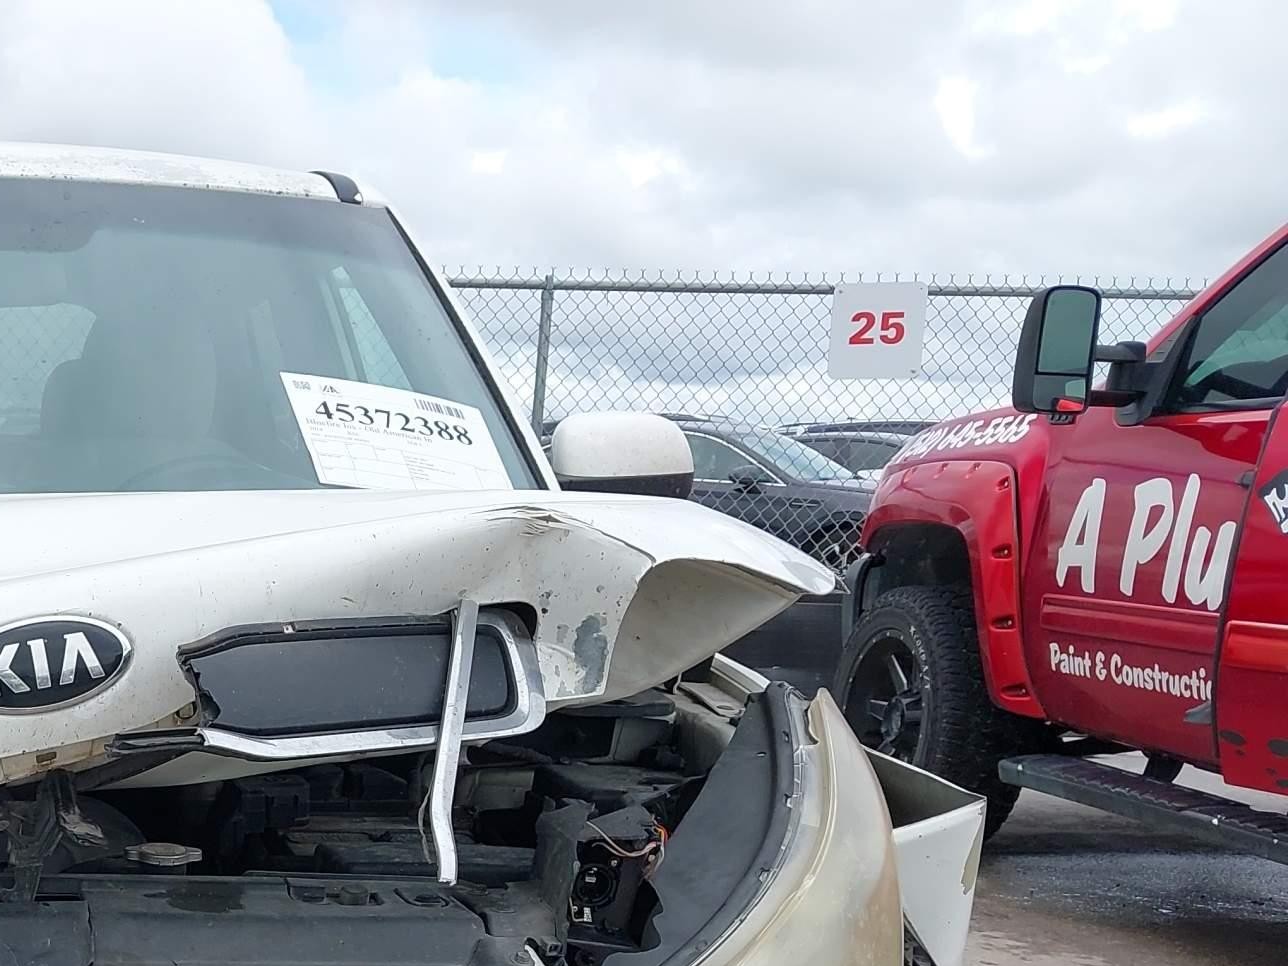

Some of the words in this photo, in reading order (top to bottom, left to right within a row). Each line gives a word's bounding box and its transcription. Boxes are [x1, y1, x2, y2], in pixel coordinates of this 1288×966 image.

[848, 311, 905, 345] 25
[315, 401, 473, 445] 45372388
[1055, 477, 1107, 594] A
[1119, 473, 1237, 611] Plu
[1049, 642, 1092, 678] Paint
[1095, 651, 1107, 680] &
